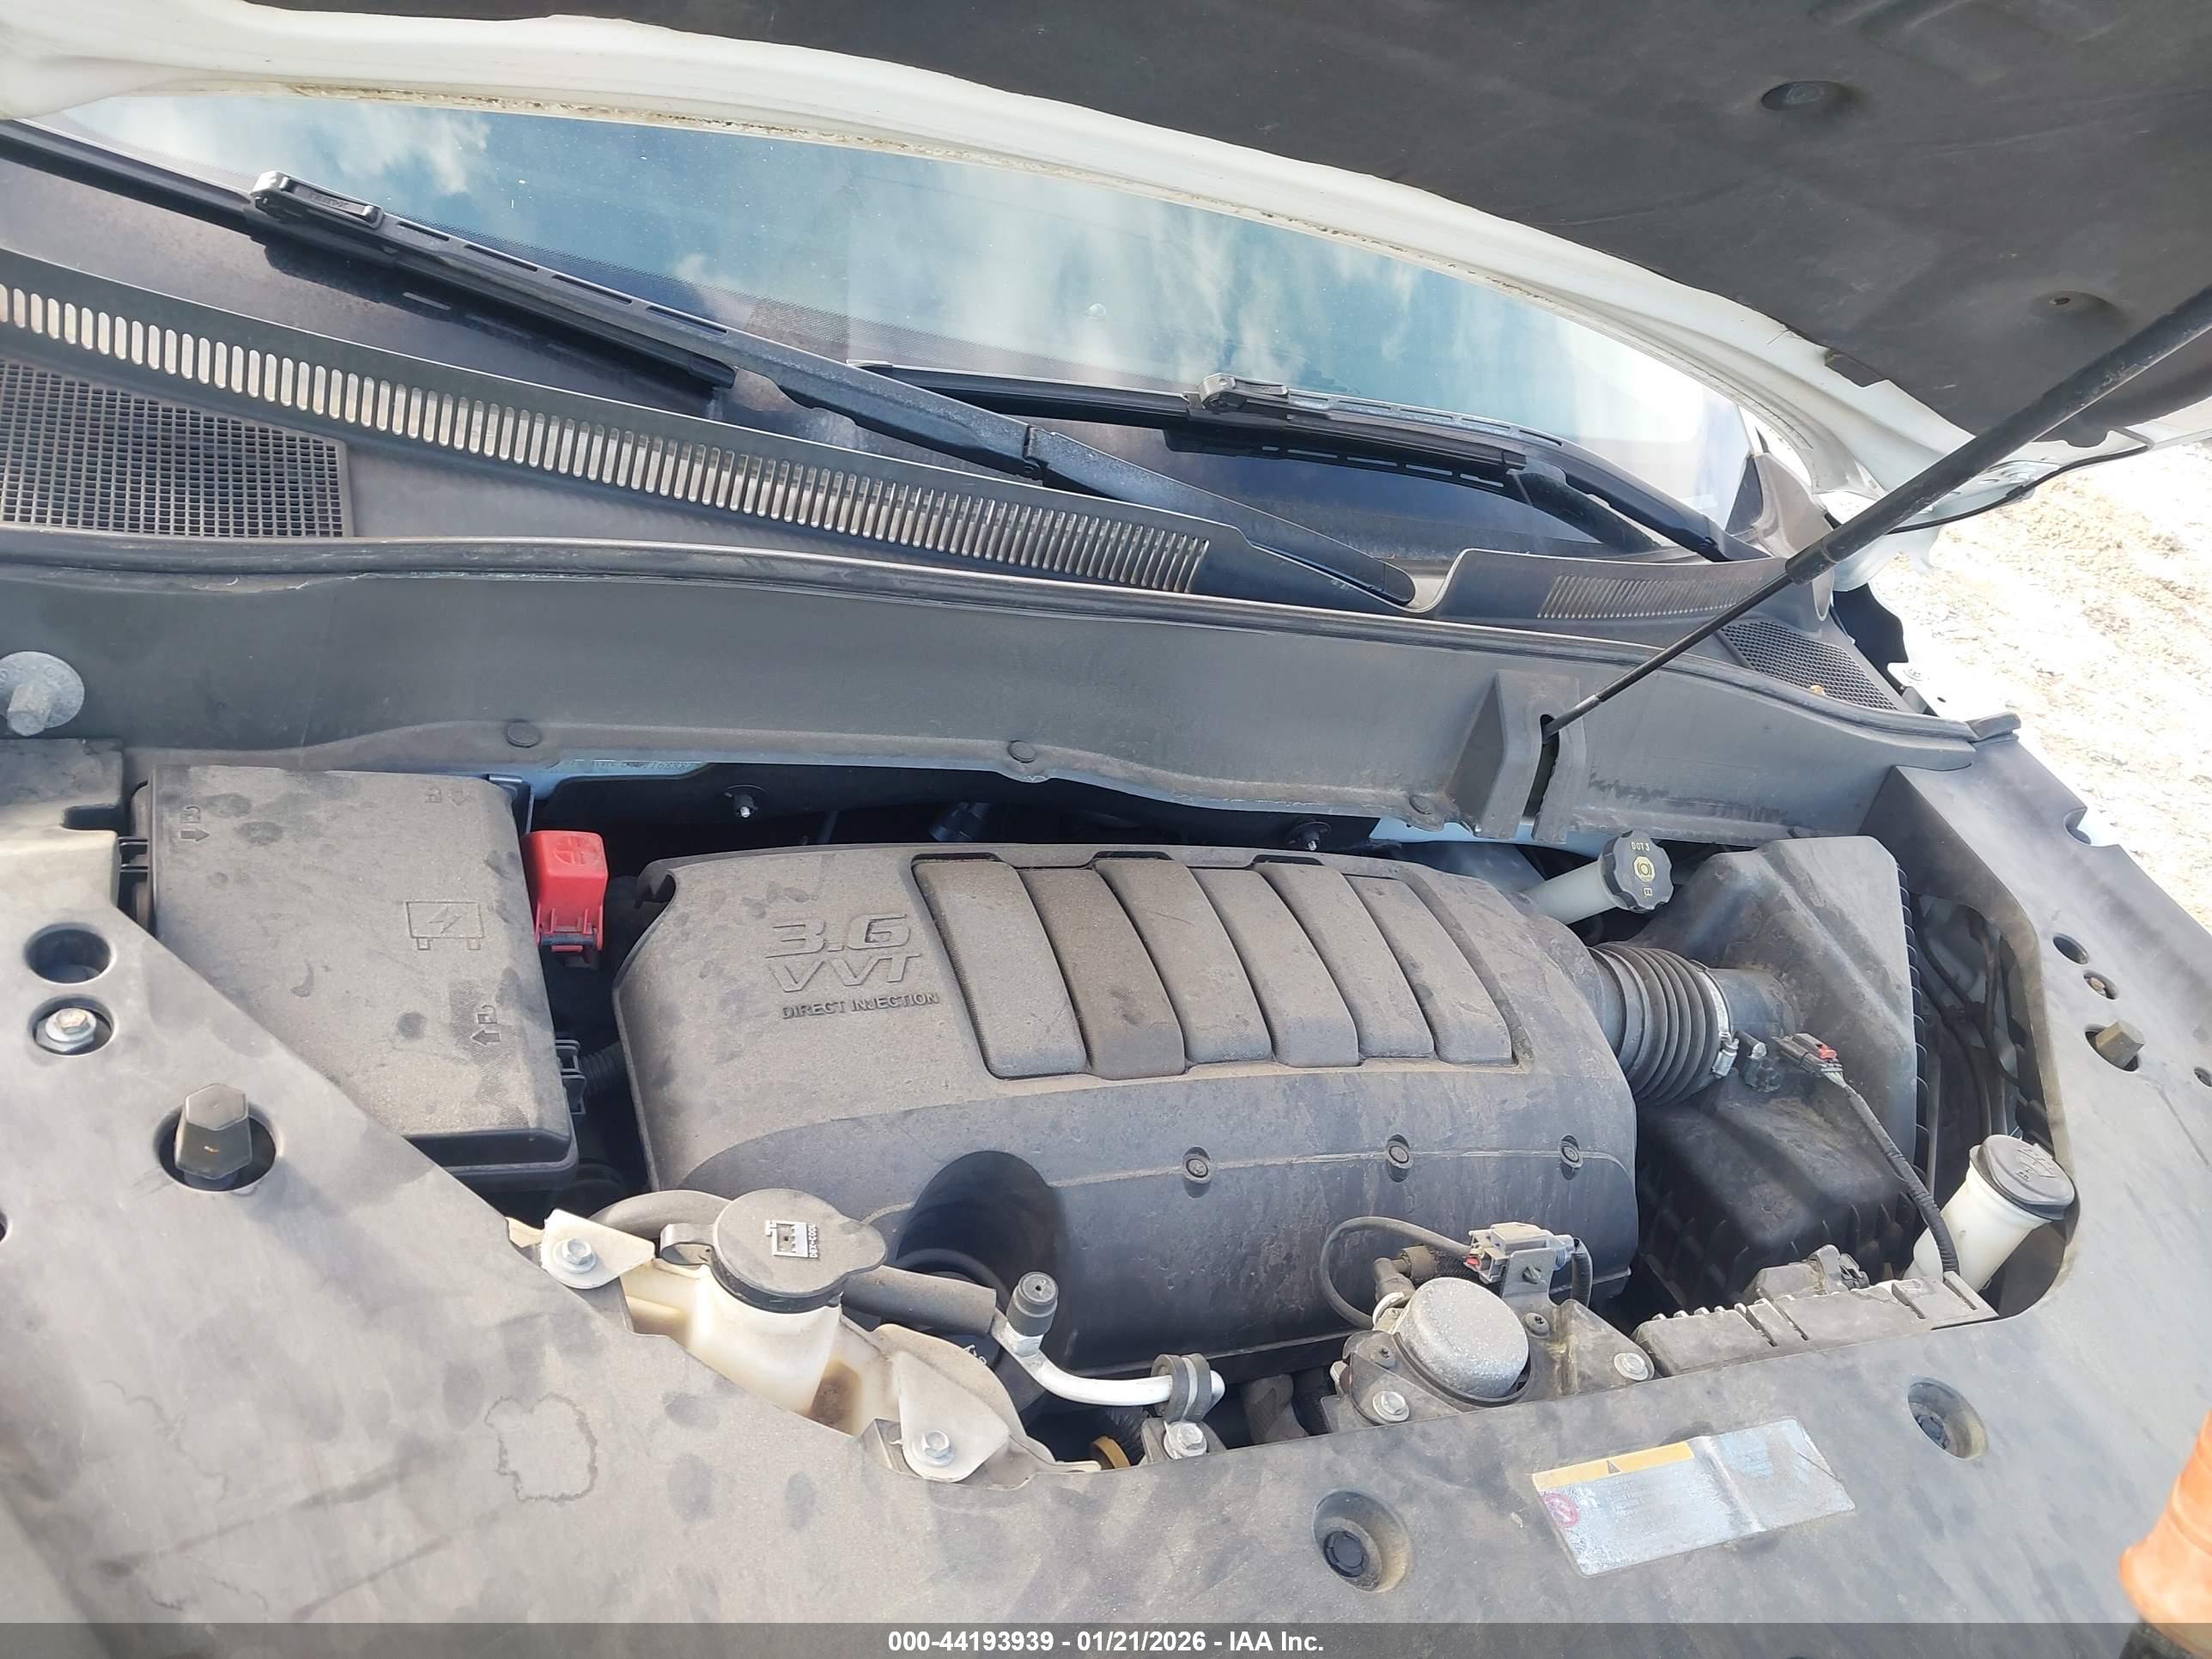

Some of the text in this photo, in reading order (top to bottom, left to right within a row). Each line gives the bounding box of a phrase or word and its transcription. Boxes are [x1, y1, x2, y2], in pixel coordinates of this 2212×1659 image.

[765, 914, 911, 959] 3.6
[768, 953, 922, 993] VVT
[782, 993, 940, 1019] DIRECT INJECTION
